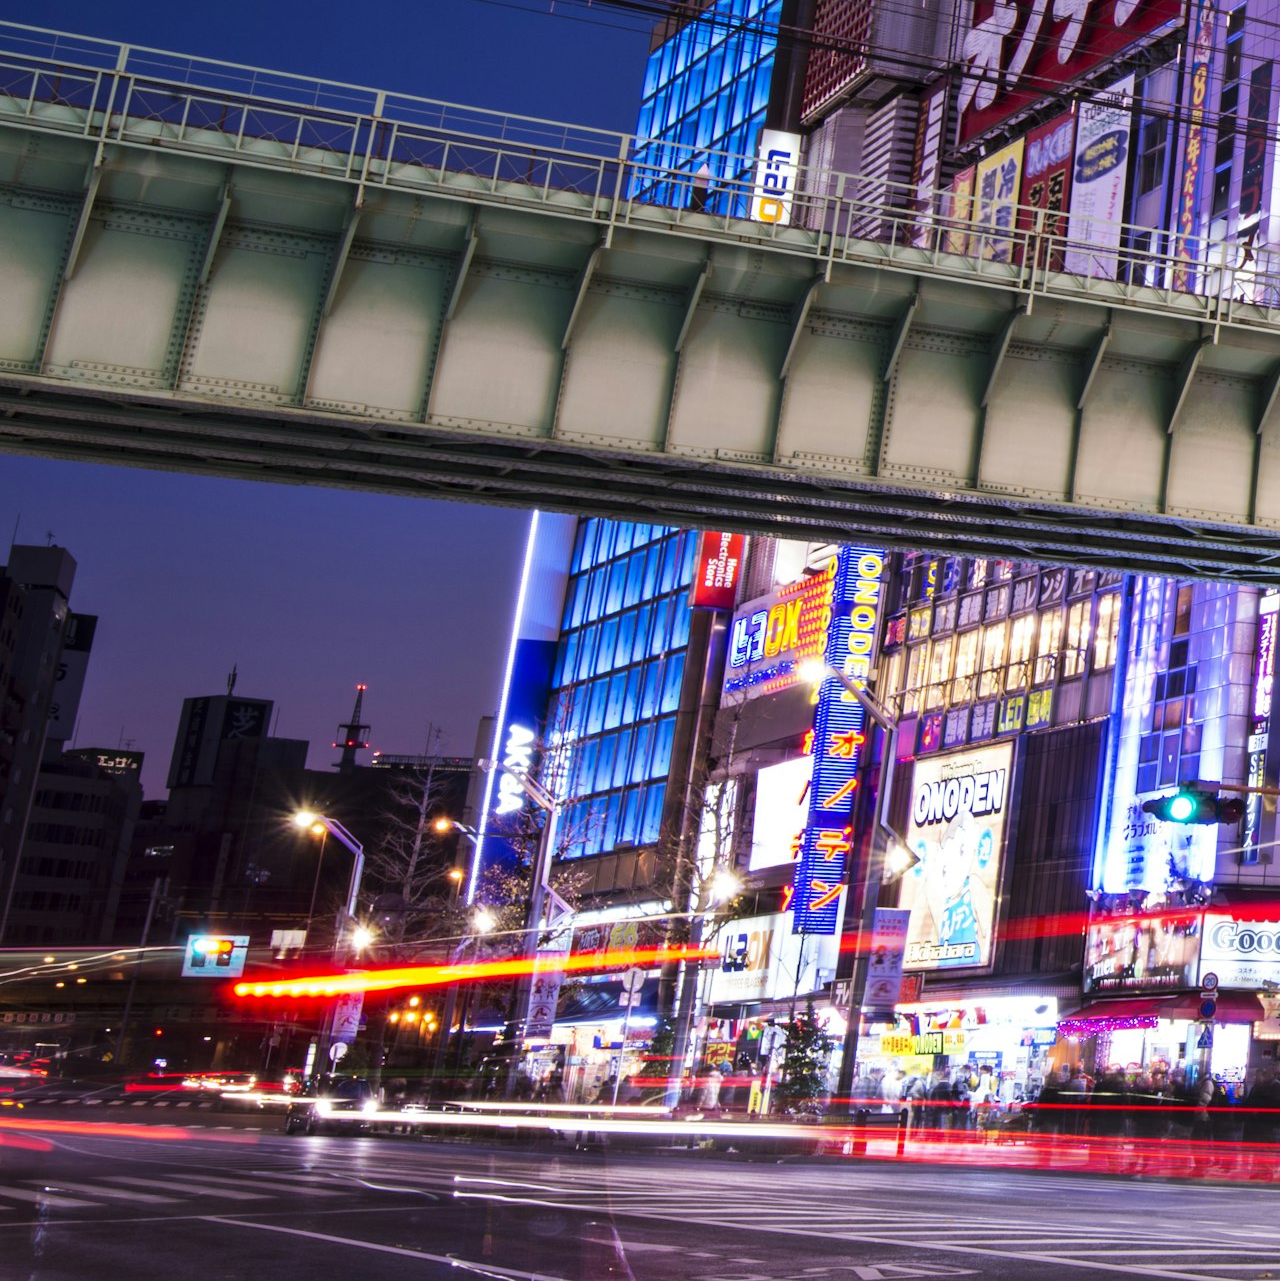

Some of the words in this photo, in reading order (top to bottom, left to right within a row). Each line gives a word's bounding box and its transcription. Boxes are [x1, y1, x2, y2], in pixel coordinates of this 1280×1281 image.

[704, 557, 718, 588] Store
[725, 557, 738, 589] Home
[914, 769, 1006, 828] ONODEN
[810, 730, 866, 911] オノデン
[1204, 977, 1216, 987] 20
